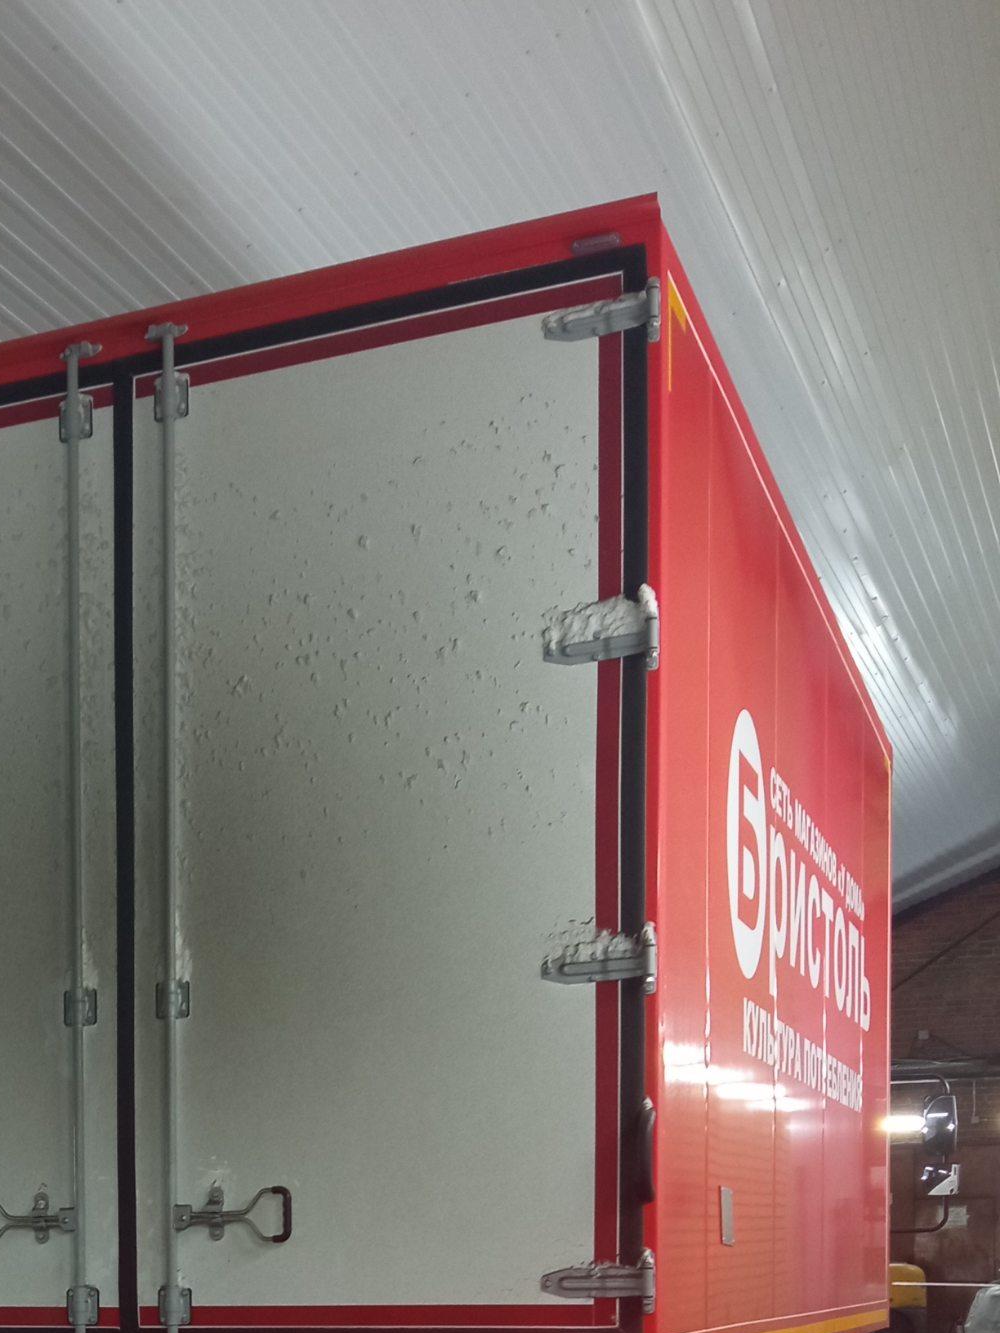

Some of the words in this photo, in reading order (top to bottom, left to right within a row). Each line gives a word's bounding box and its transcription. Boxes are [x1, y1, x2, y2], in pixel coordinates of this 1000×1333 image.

[770, 767, 793, 829] СЕТЬ
[795, 798, 836, 887] МАГАЗИНОВ
[743, 997, 802, 1082] КУЛЬТУРА
[803, 1038, 862, 1113] ПОТРЕБЛЕНИЯ
